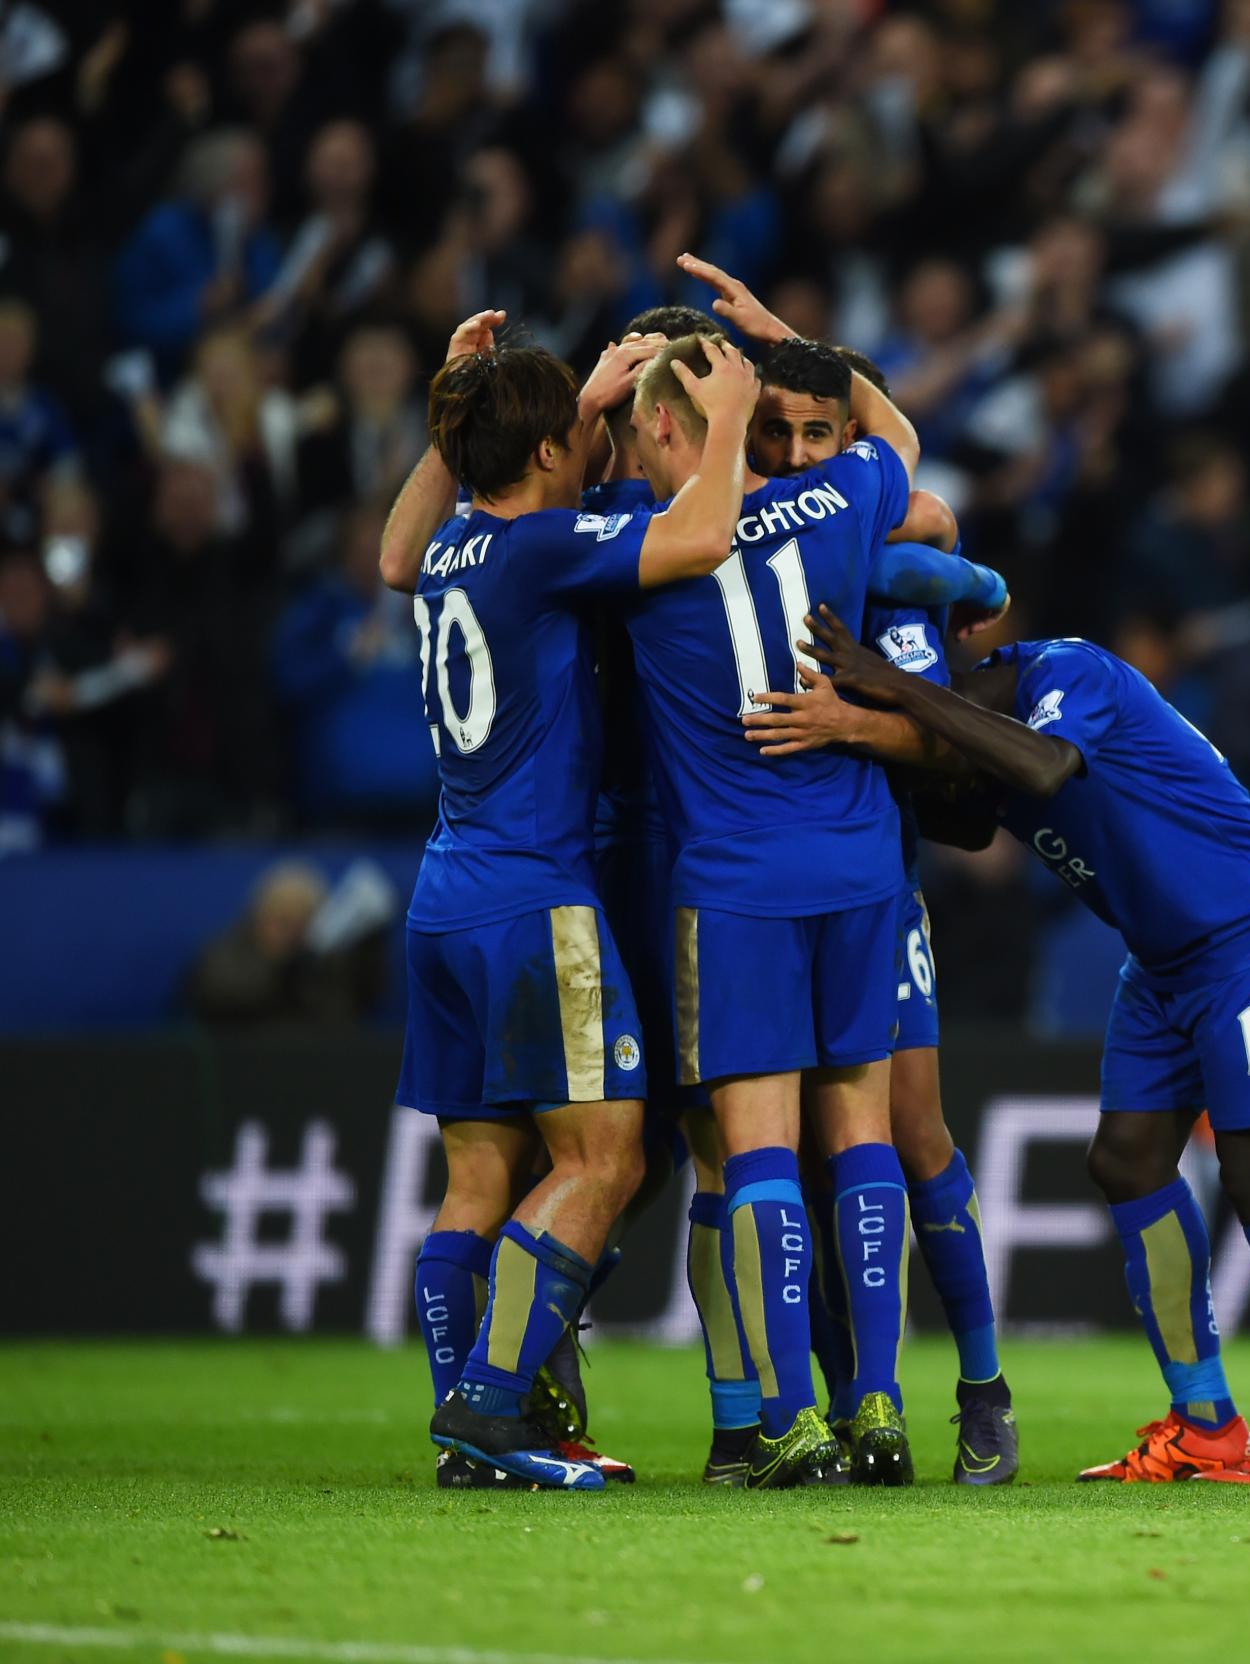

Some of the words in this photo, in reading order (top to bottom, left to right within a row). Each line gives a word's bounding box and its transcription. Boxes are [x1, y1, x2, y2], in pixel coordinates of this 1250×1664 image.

[732, 481, 849, 546] GHTON
[711, 537, 822, 718] 11
[780, 1208, 804, 1304] LCFC
[857, 1194, 886, 1288] LCFC
[423, 1286, 456, 1365] LCFC
